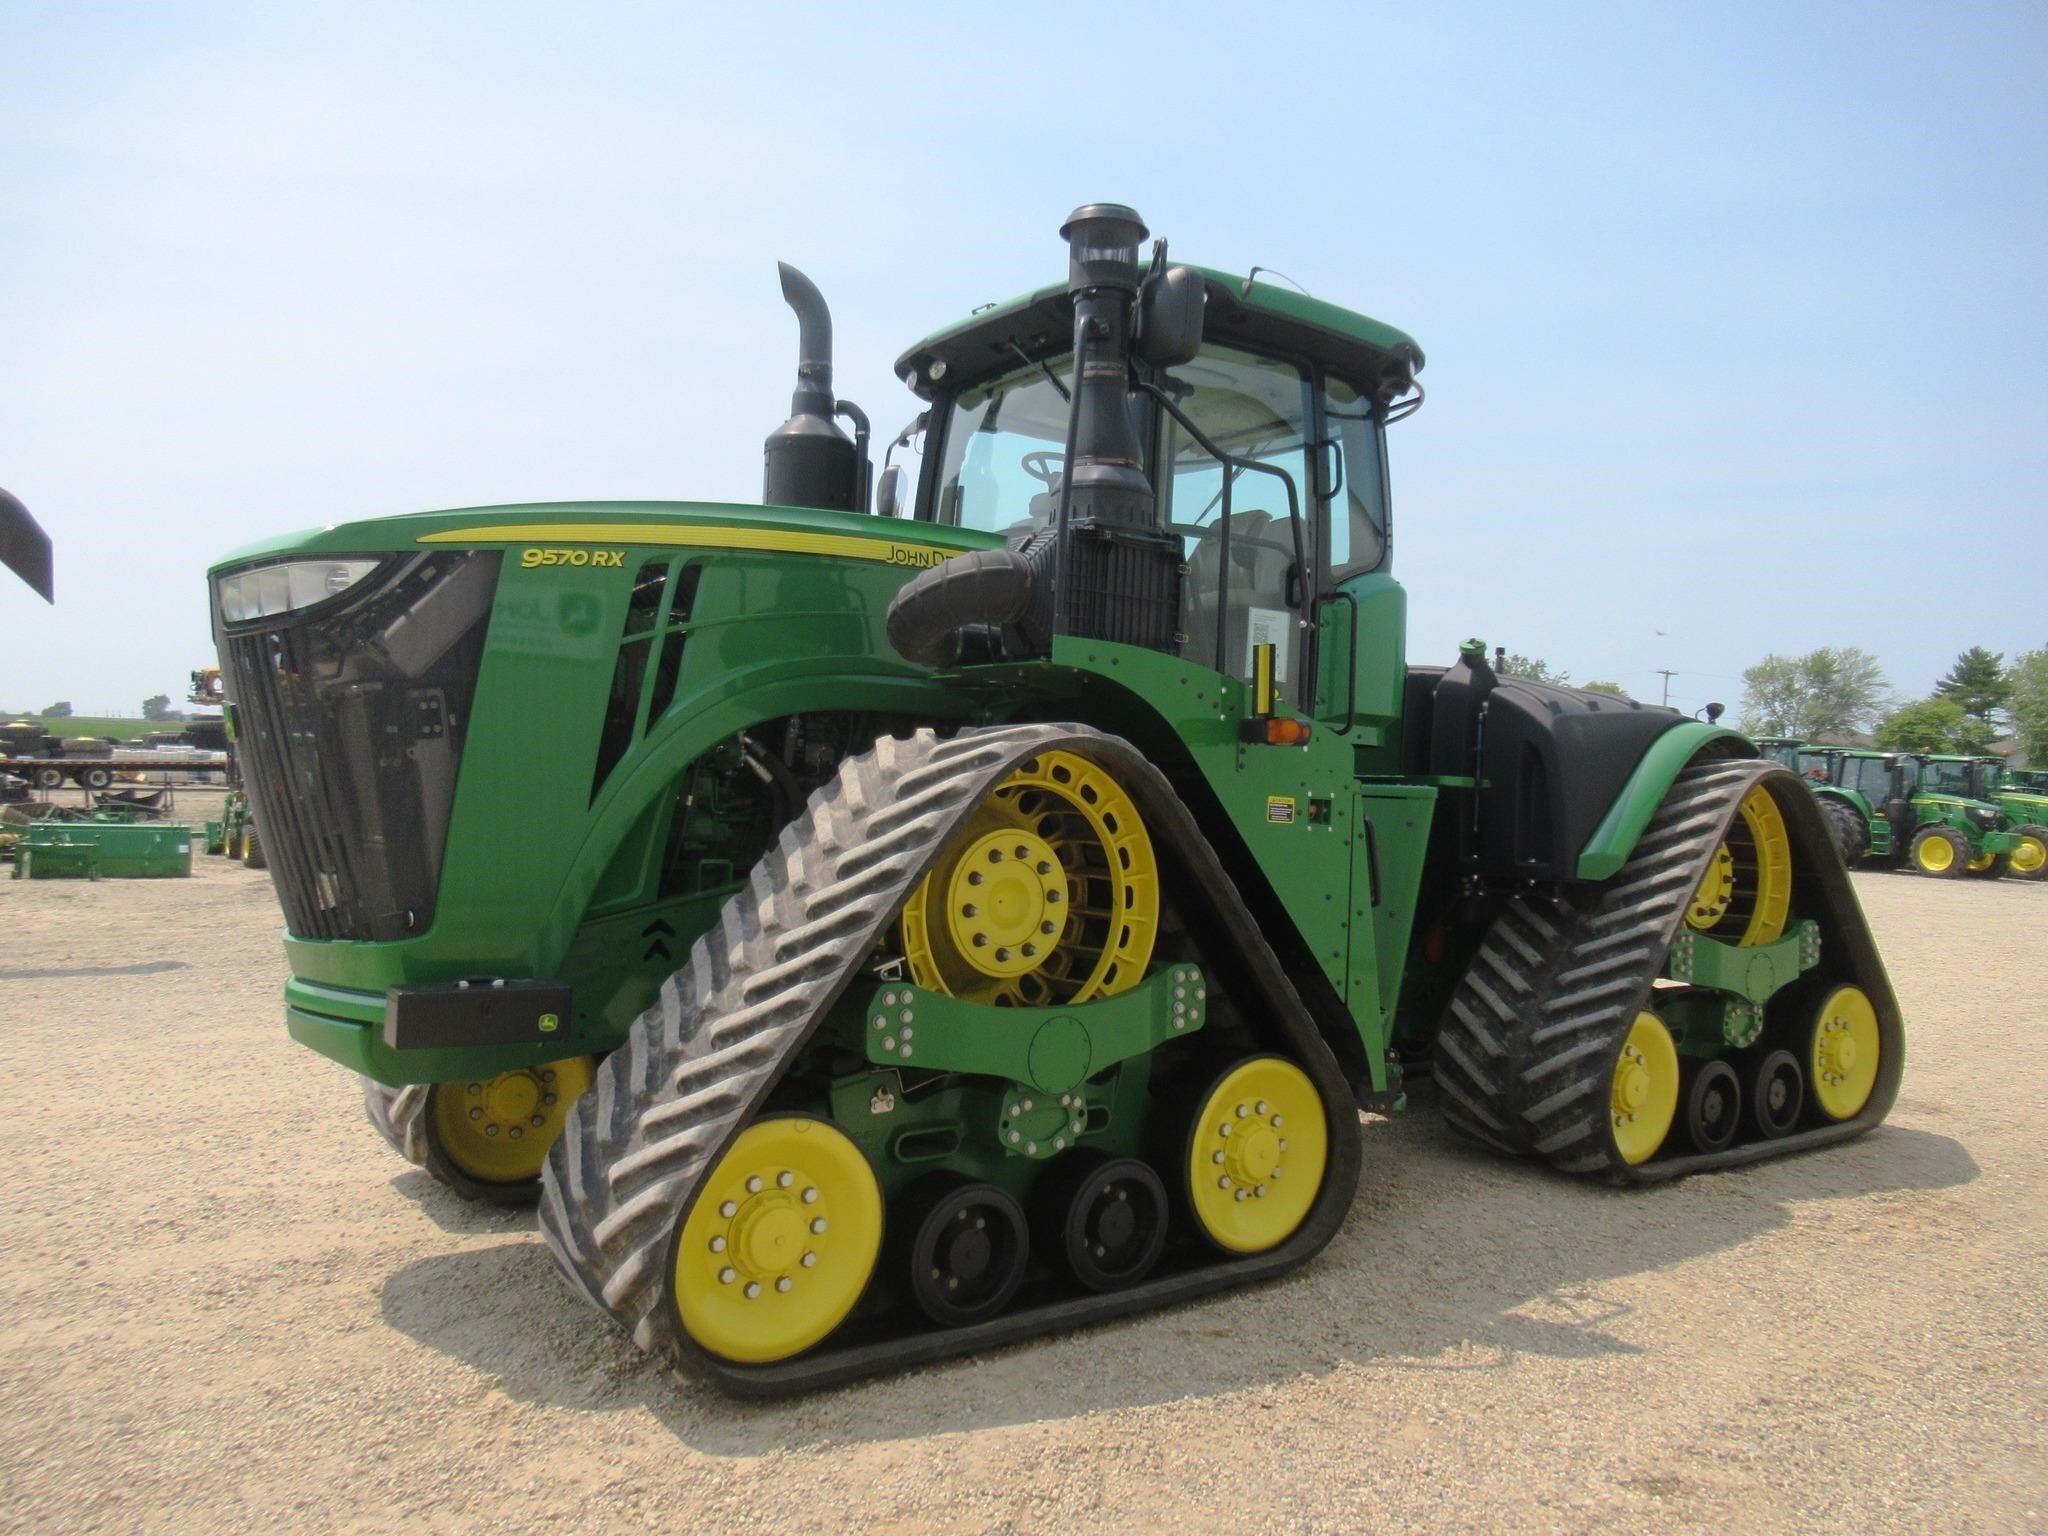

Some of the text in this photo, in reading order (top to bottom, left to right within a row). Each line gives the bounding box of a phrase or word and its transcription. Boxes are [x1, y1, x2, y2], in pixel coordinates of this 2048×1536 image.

[522, 548, 626, 568] 9570 RX
[887, 545, 929, 567] JOHN
